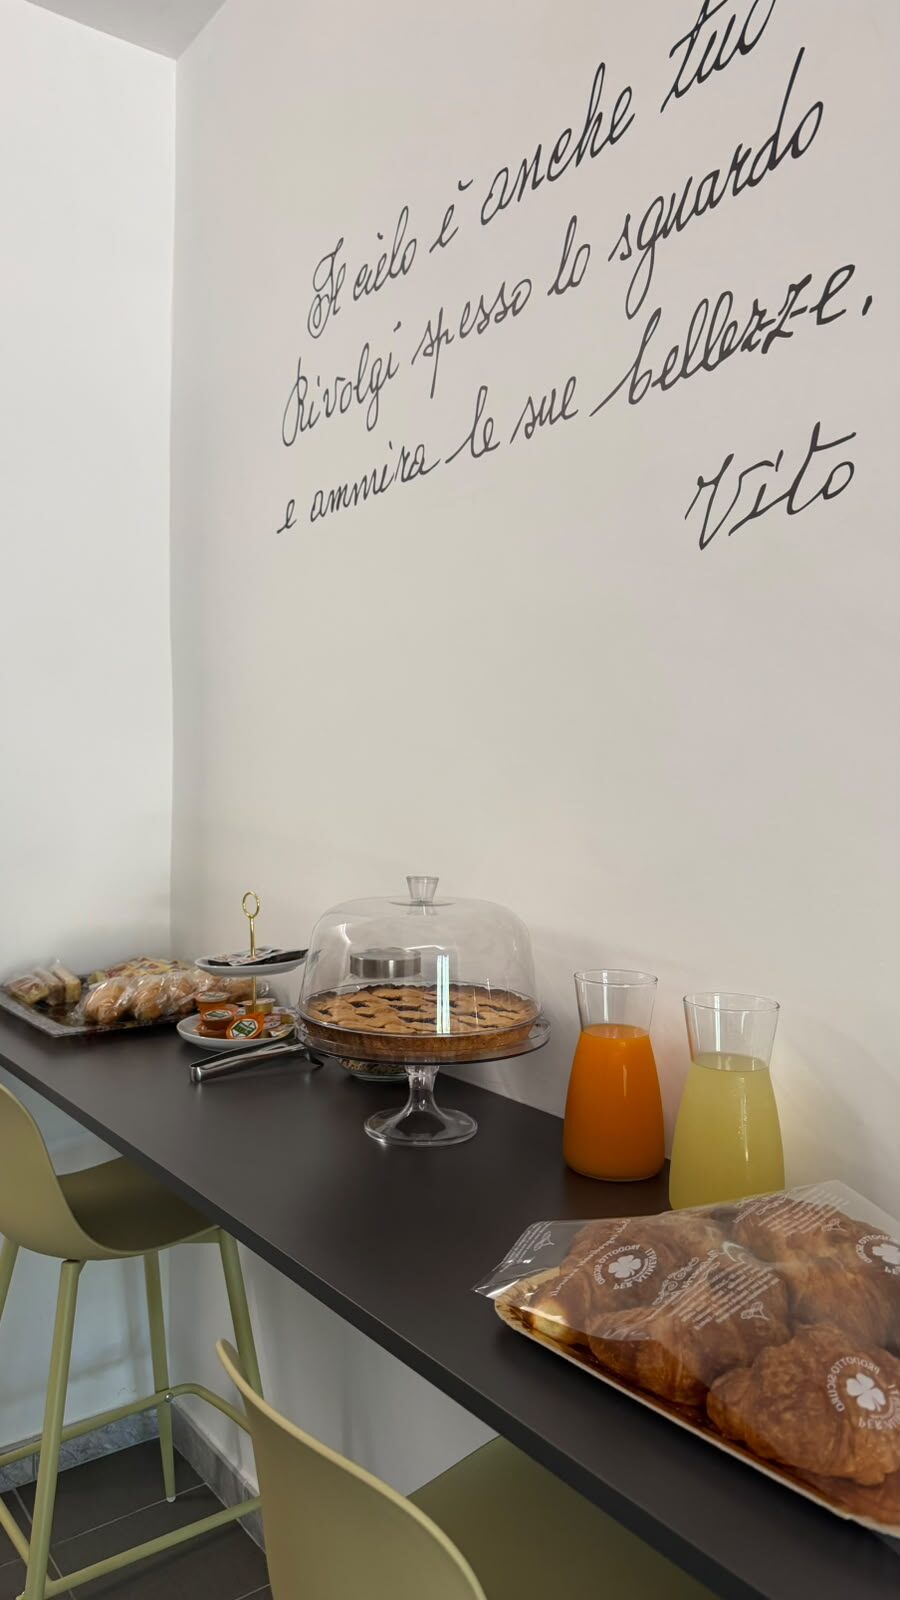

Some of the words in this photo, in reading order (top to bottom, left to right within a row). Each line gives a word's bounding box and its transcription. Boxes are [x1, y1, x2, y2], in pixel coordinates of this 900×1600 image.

[282, 321, 402, 447] Rivolgi
[411, 278, 533, 400] spesso
[547, 214, 591, 297] lo
[608, 46, 824, 321] sguardo
[353, 205, 418, 302] cielo
[480, 61, 636, 226] anche
[660, 0, 777, 113] tuo
[276, 498, 297, 534] e
[310, 440, 441, 523] ammira
[444, 385, 501, 464] le
[509, 375, 579, 445] sue
[684, 420, 857, 551] Vito
